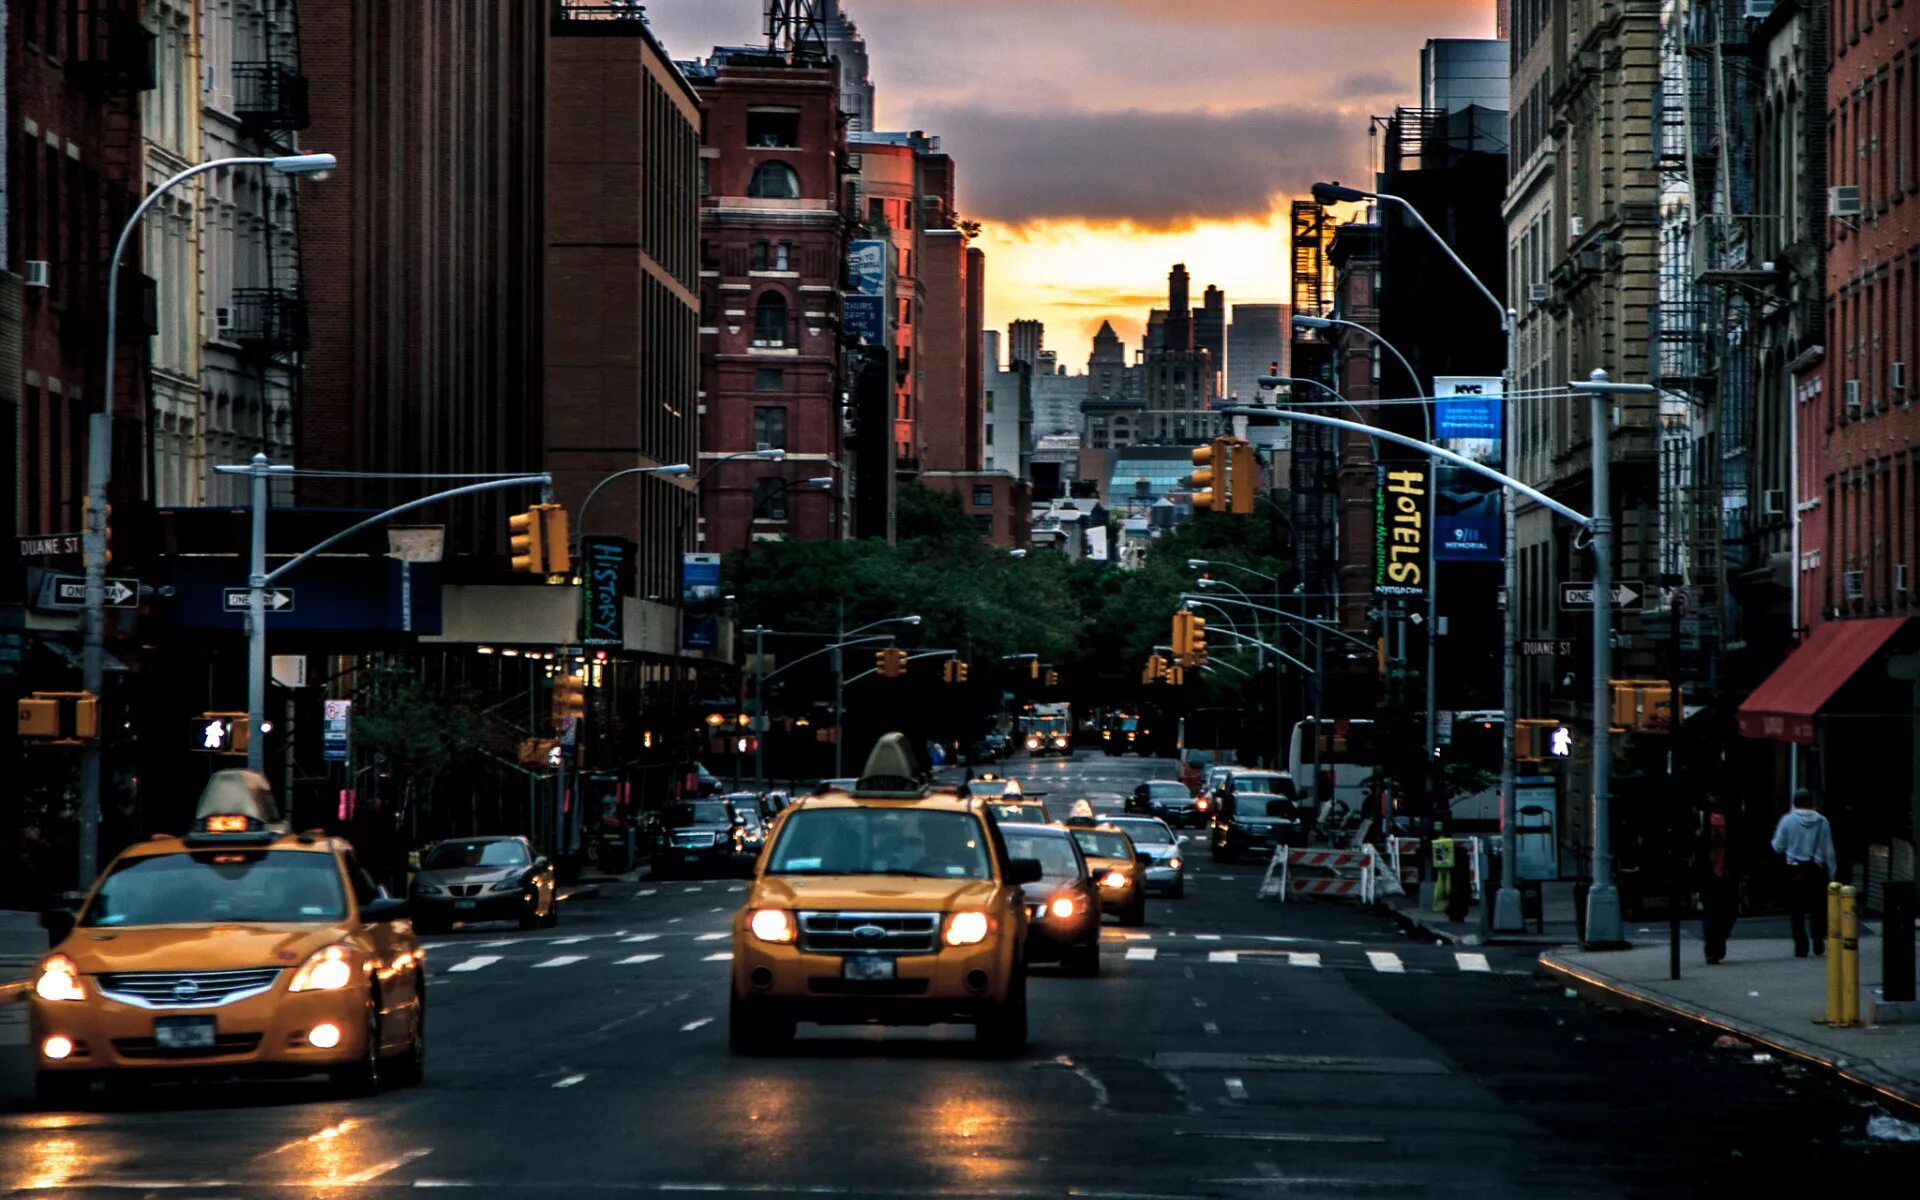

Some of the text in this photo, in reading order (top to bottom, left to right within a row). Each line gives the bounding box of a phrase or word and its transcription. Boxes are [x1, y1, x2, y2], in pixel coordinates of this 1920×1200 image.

[1455, 384, 1483, 394] NYC
[1454, 528, 1479, 541] 9/11
[20, 537, 79, 556] DUANE ST
[1444, 541, 1488, 550] MEMORIAL
[67, 586, 85, 598] ON
[1569, 591, 1592, 602] ONE
[1523, 641, 1571, 656] DUANE ST
